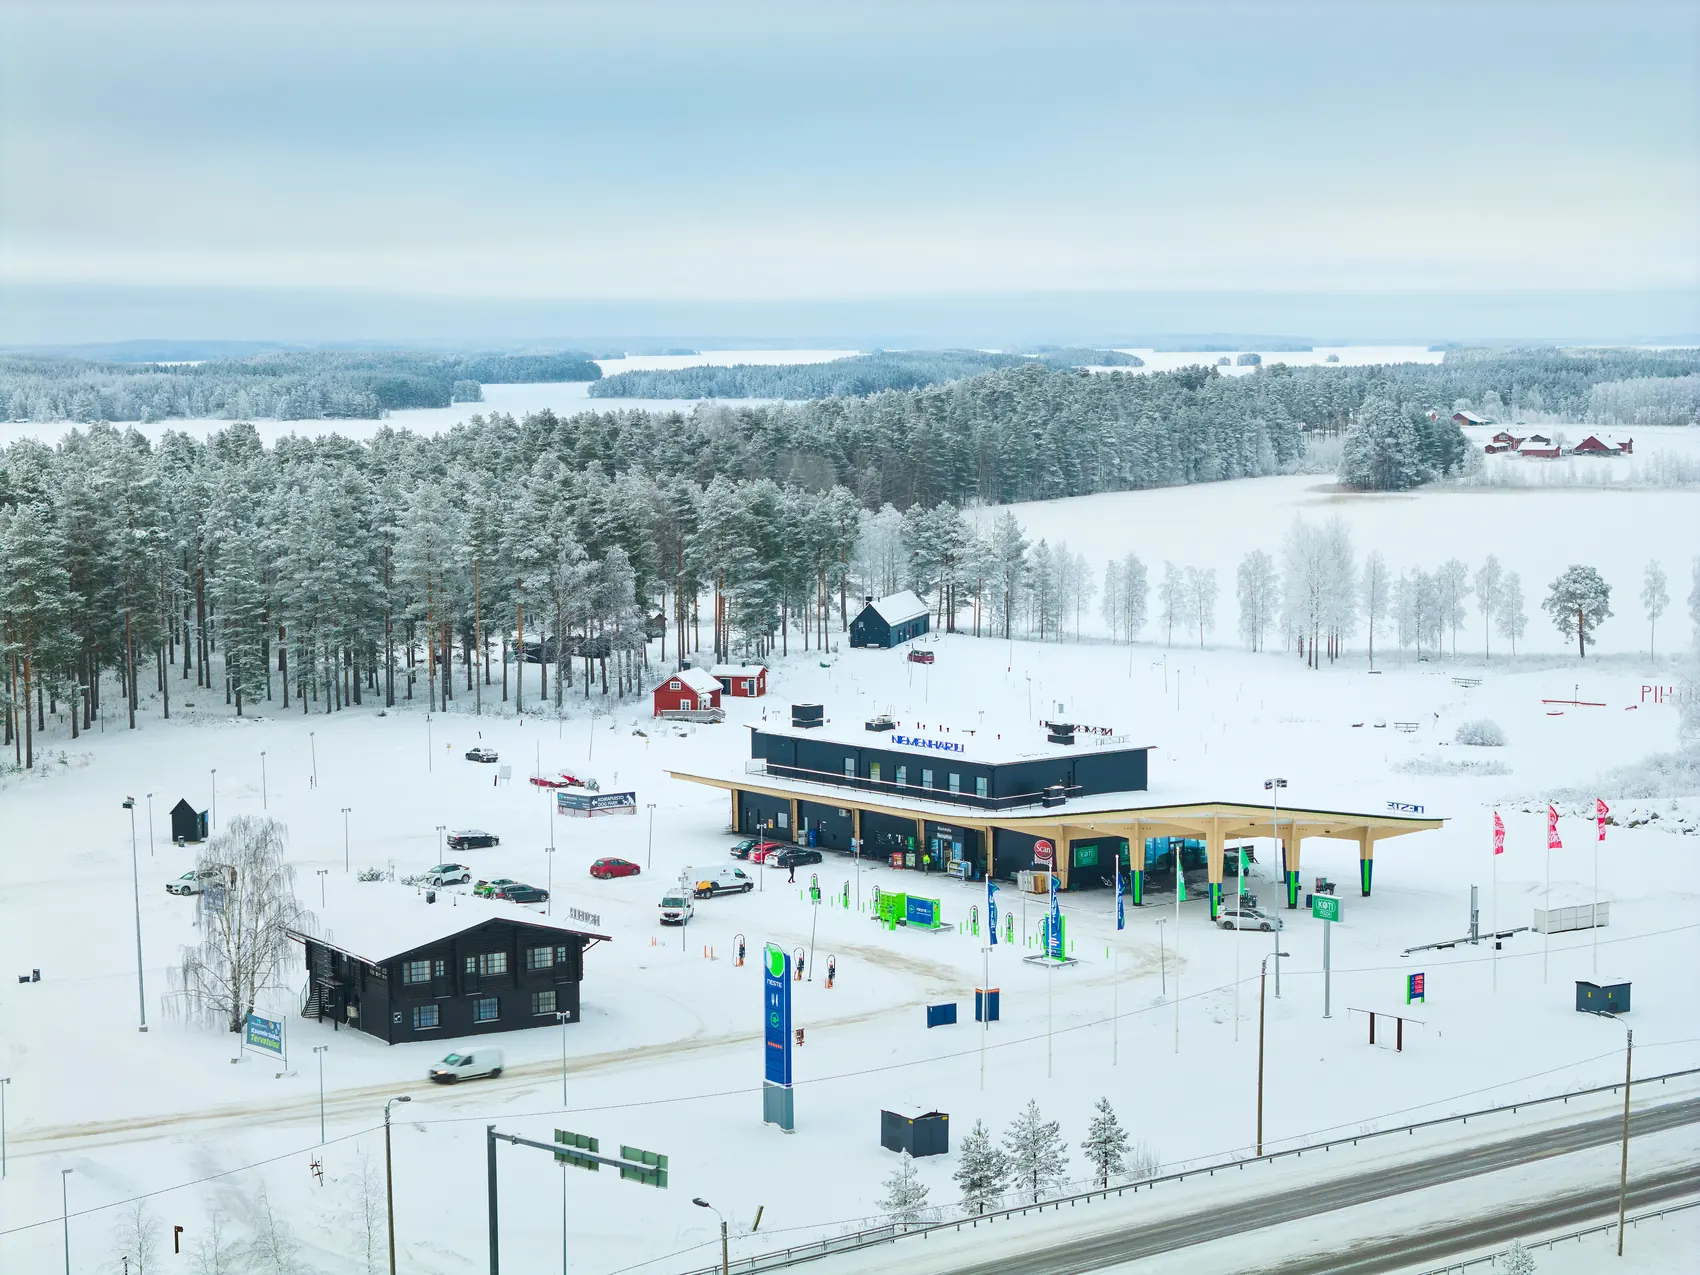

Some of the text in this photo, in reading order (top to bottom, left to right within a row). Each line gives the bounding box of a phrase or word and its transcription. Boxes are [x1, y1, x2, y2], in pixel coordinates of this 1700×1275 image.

[892, 735, 965, 753] NIEMENHARJU
[1036, 843, 1051, 854] Scan
[1317, 900, 1334, 910] KOTI
[767, 979, 782, 989] NESTE
